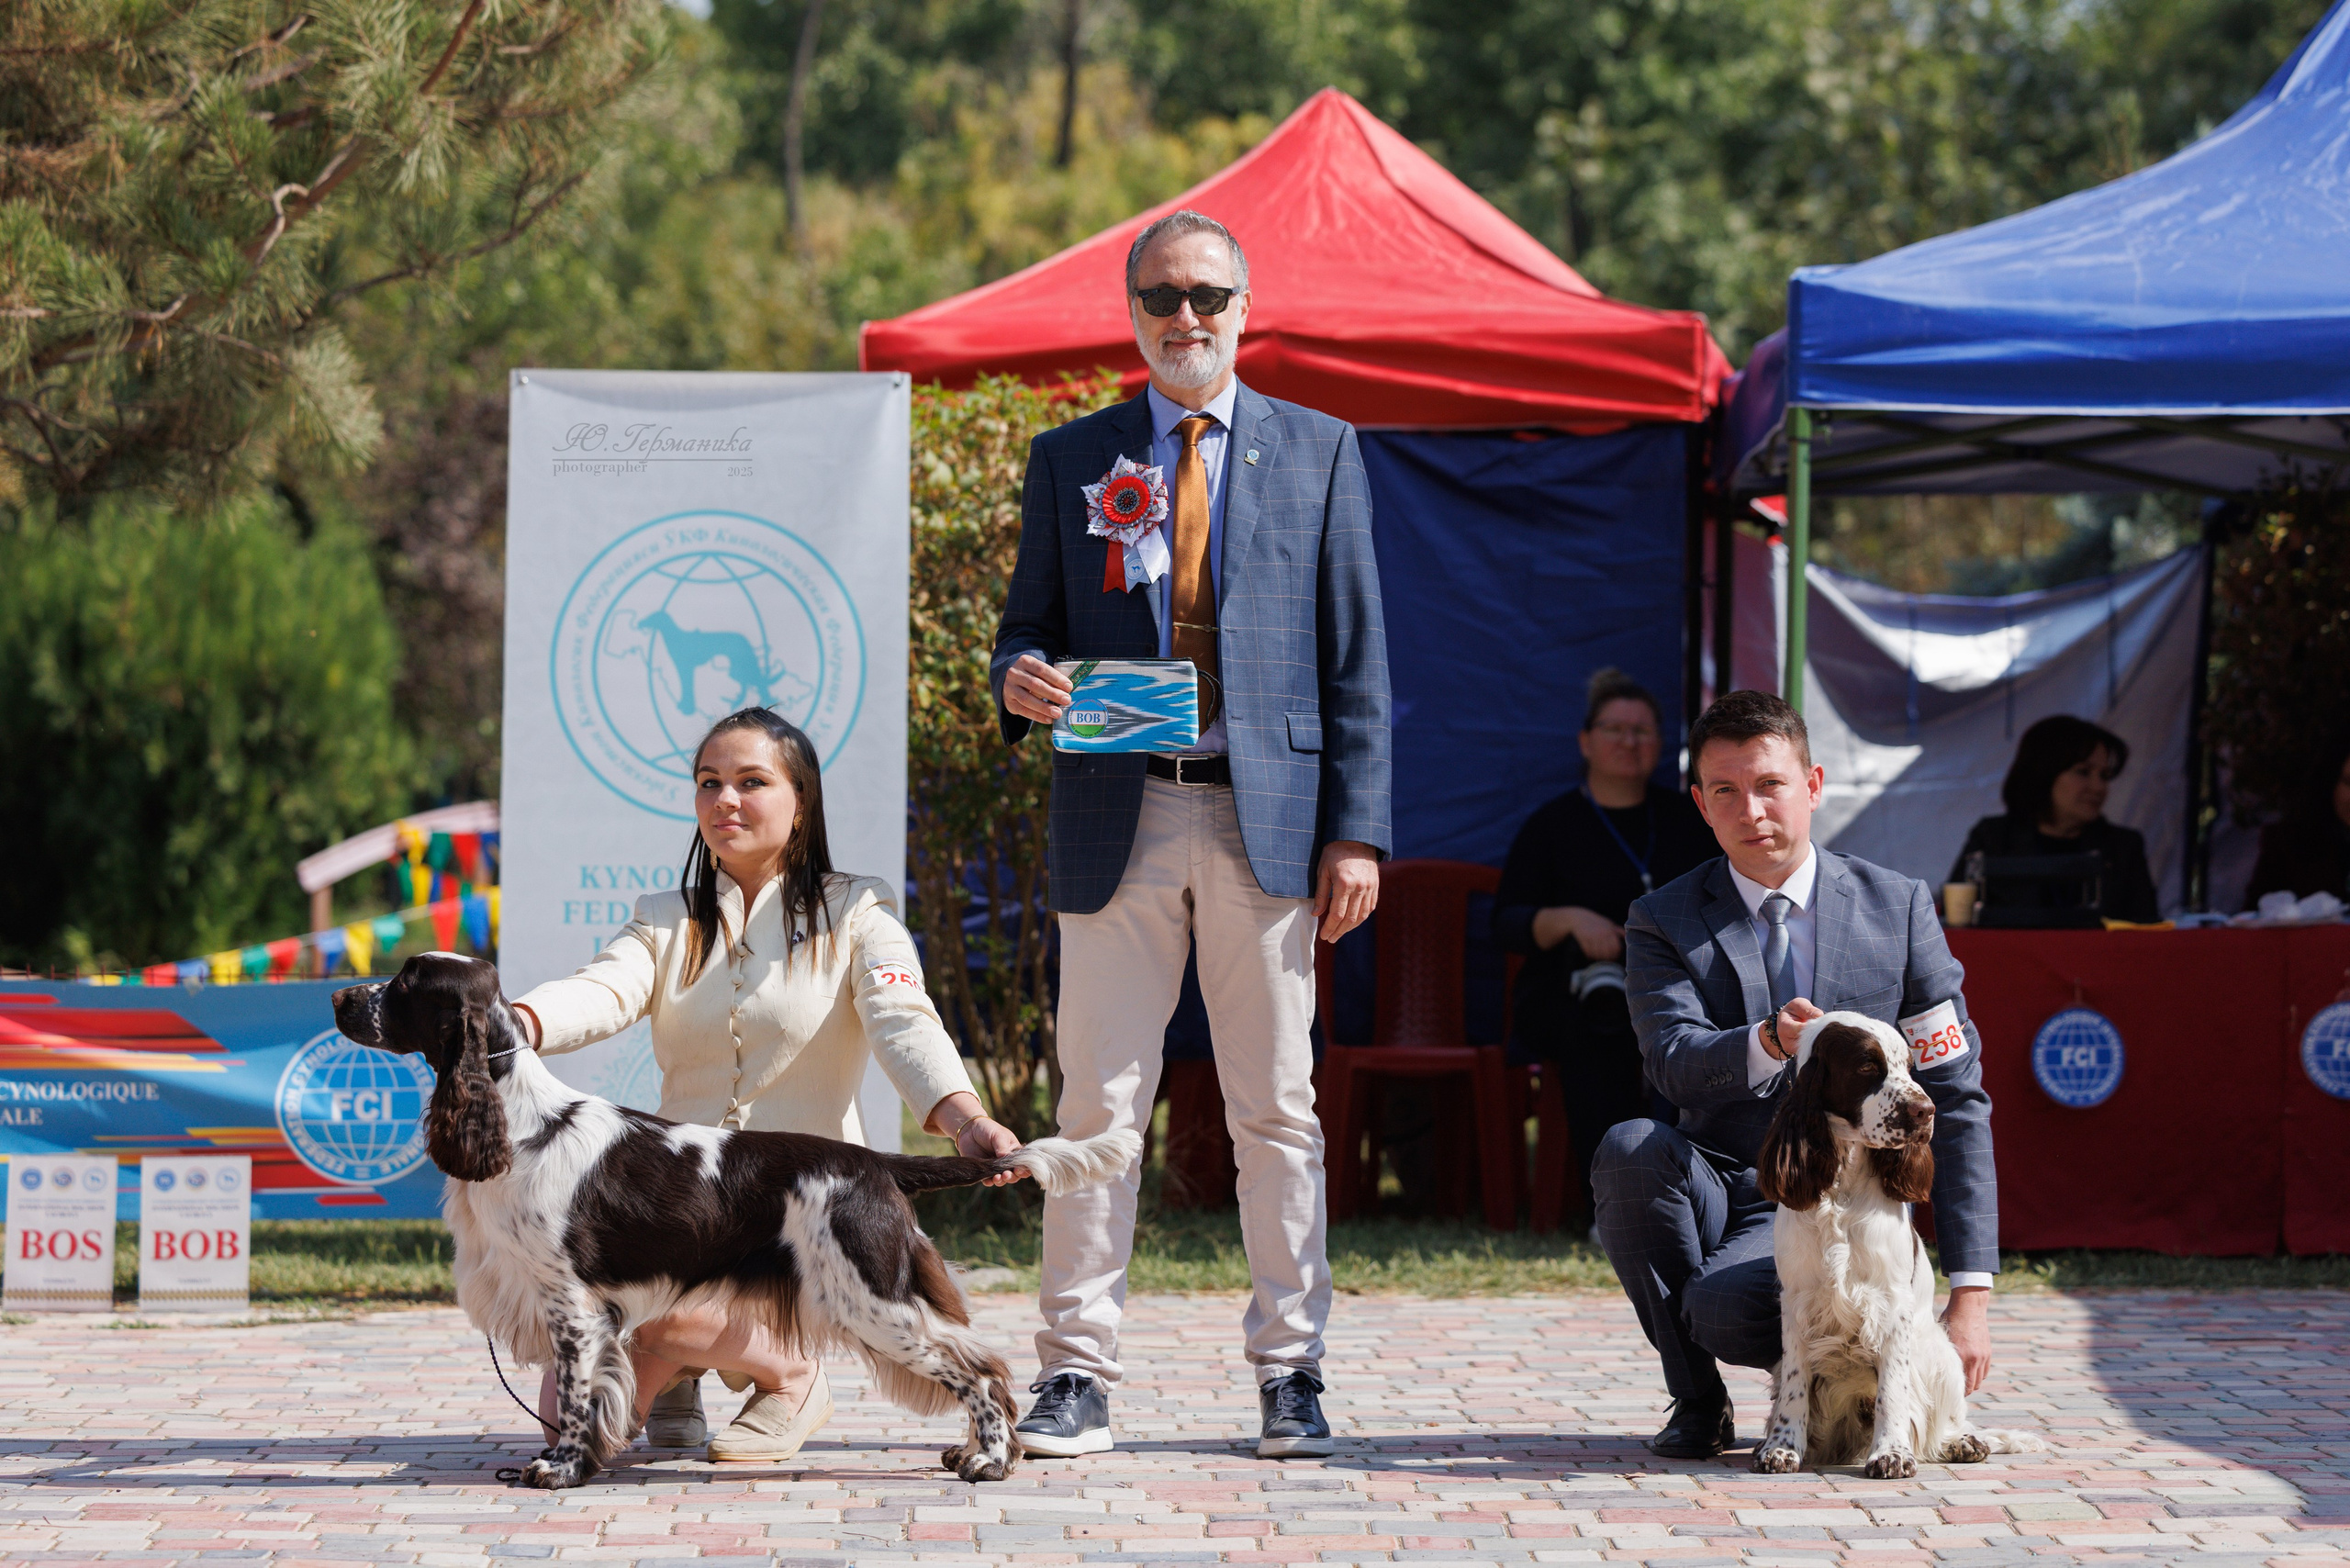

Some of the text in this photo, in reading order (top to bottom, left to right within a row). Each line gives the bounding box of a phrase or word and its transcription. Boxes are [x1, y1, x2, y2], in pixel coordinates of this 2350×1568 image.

[1076, 712, 1101, 723] BOB
[1915, 1025, 1962, 1064] 258
[2062, 1047, 2098, 1068] FCI
[0, 1081, 160, 1103] CYNOLOGIQUE
[331, 1090, 392, 1123] FCI
[20, 1228, 103, 1261] BOS
[152, 1228, 240, 1261] BOB
